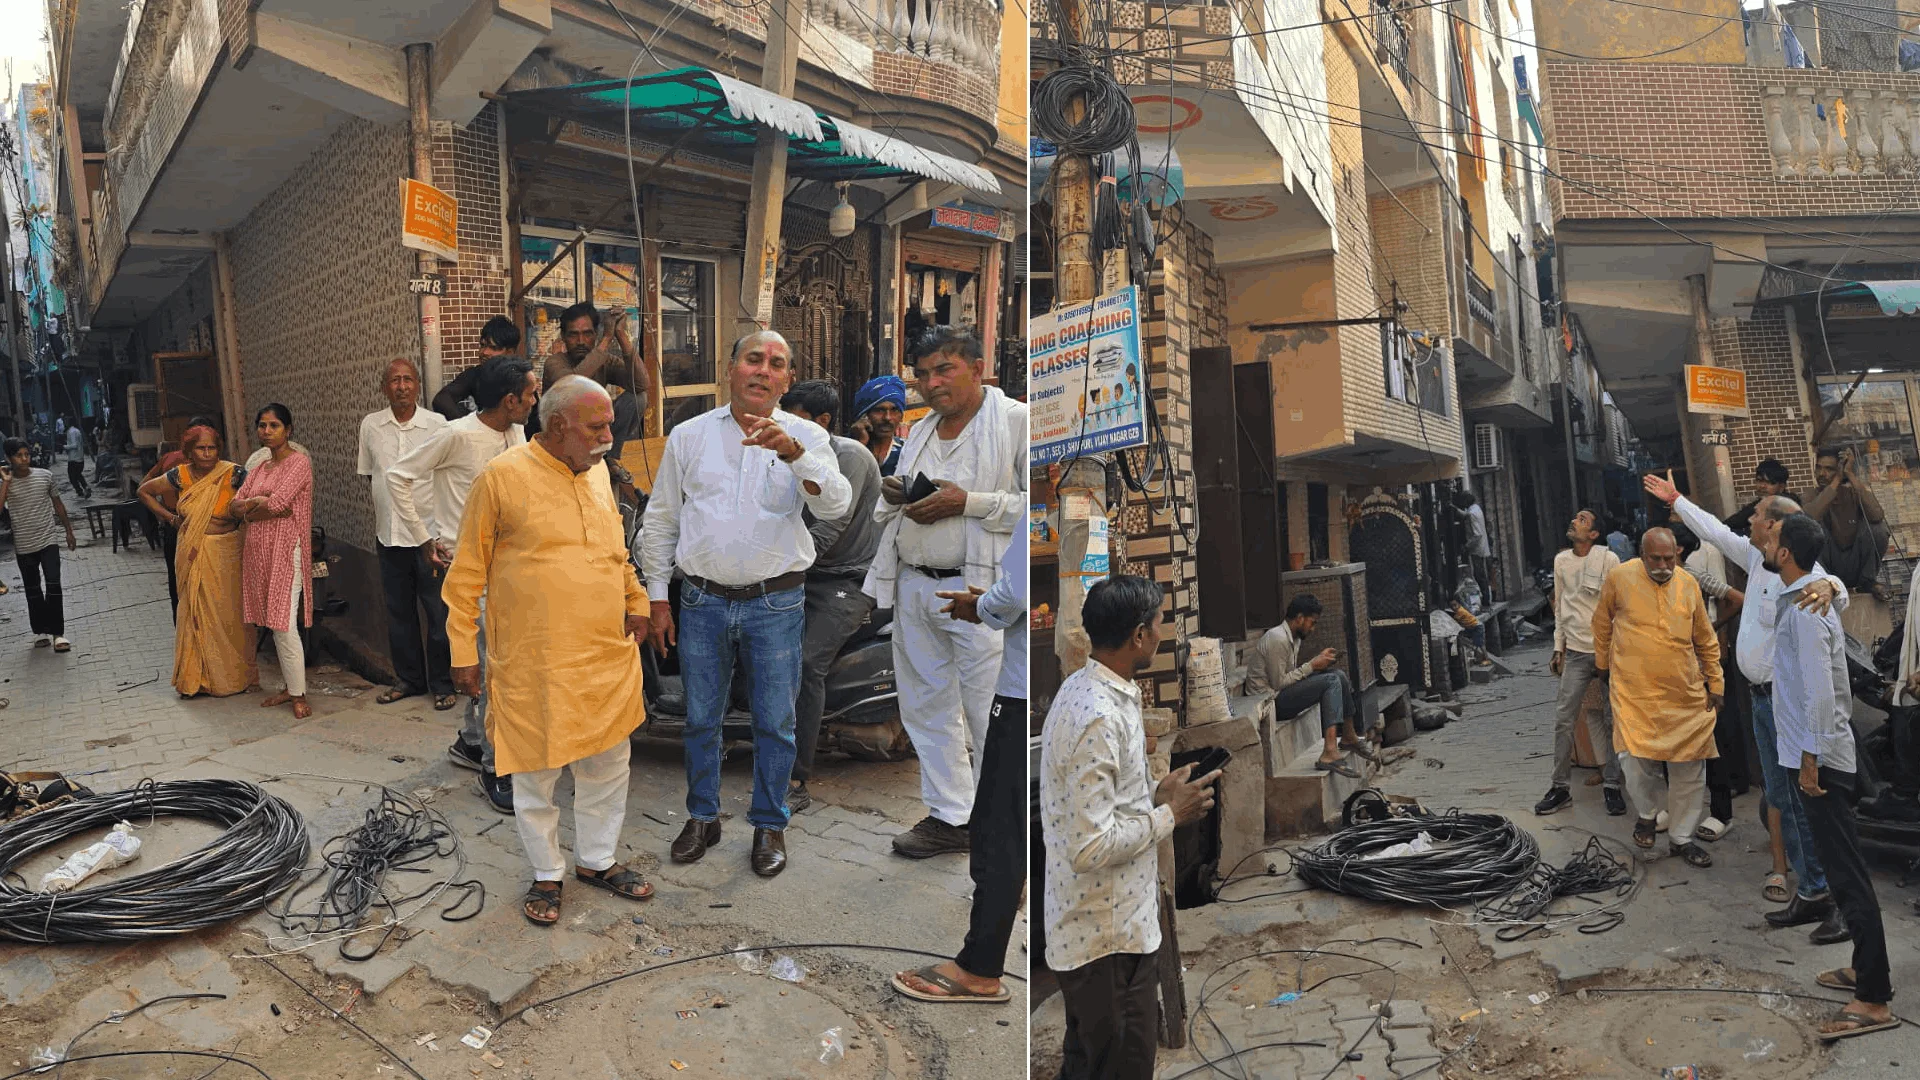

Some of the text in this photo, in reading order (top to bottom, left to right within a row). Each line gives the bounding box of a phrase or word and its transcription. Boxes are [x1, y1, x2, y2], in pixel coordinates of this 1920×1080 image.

[414, 193, 454, 225] Excitel
[409, 273, 441, 295] गली 8
[1060, 310, 1132, 345] COACHING
[1032, 346, 1089, 379] CLASSES
[1696, 373, 1740, 391] Excitel
[1094, 433, 1109, 449] VIJAY
[1110, 429, 1128, 446] NAGAR
[1702, 429, 1728, 444] गली 8
